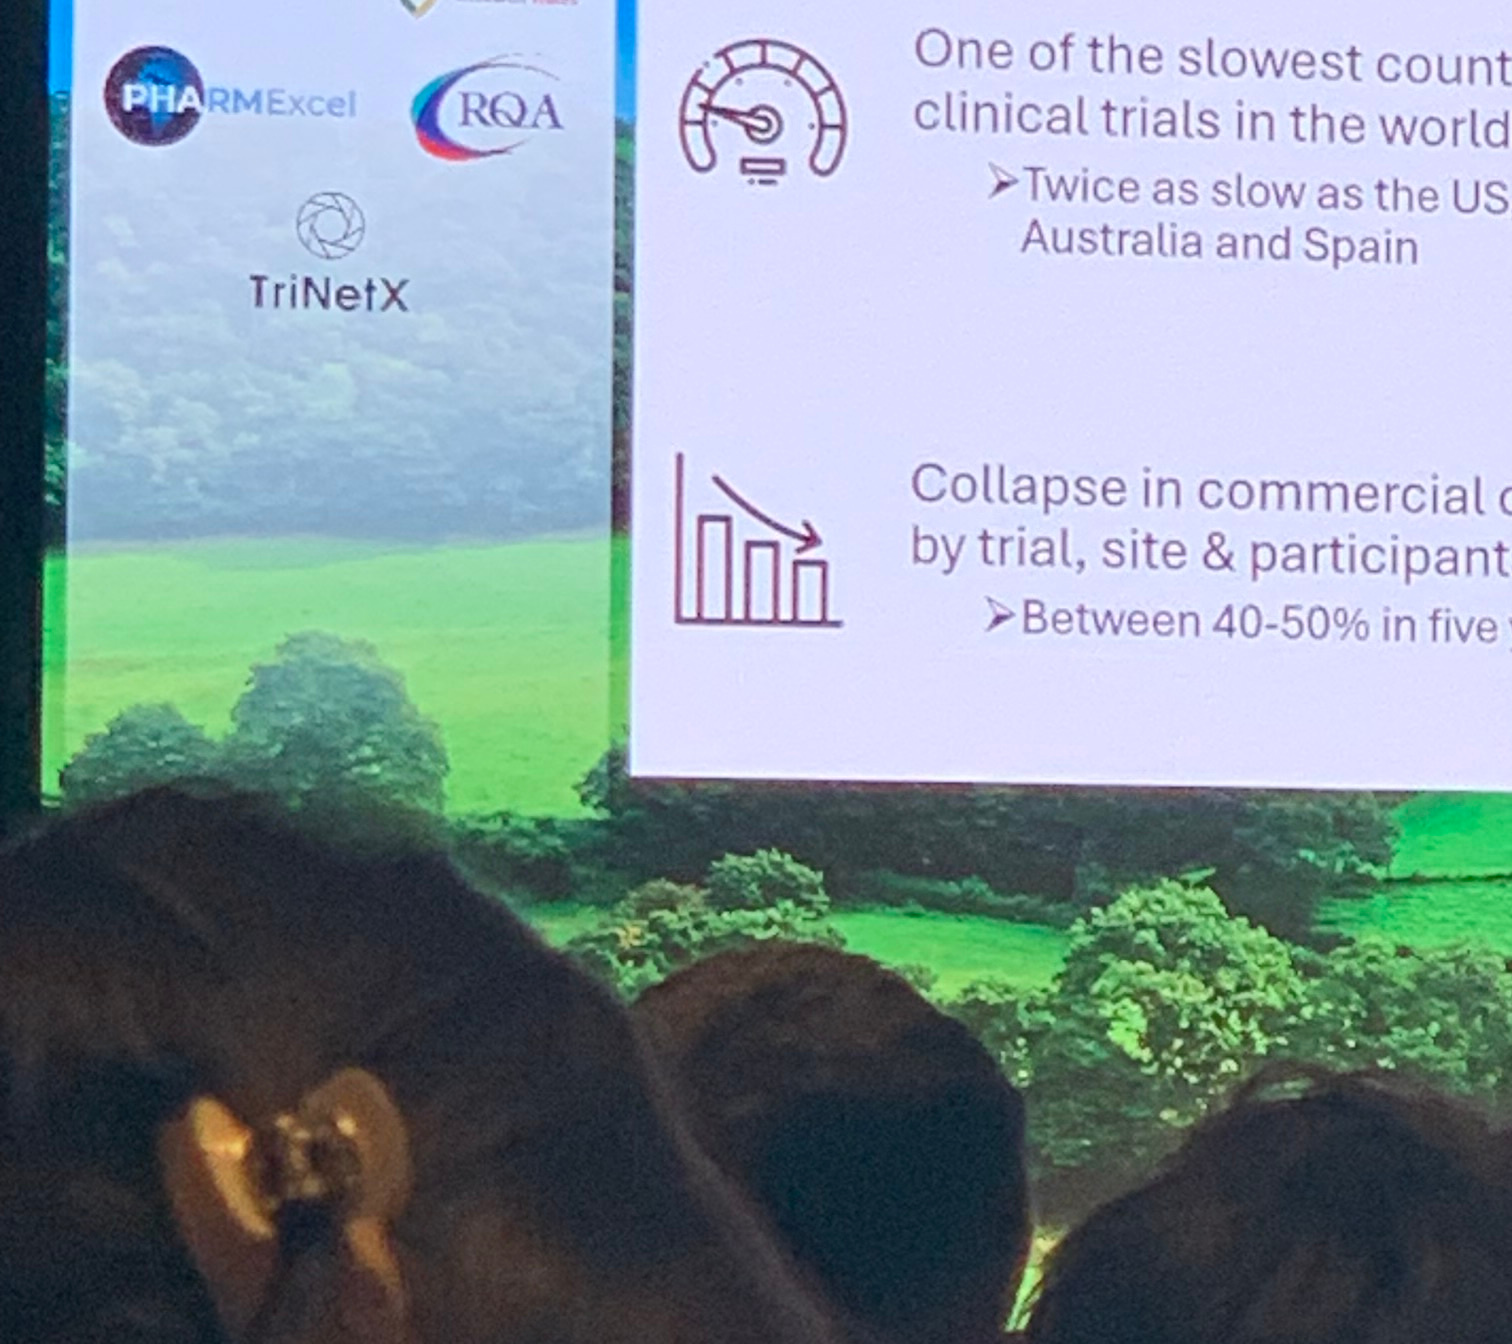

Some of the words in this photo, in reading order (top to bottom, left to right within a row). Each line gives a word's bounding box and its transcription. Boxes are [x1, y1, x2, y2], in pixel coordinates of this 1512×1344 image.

[916, 28, 1012, 69] One
[1030, 33, 1074, 71] of
[1087, 35, 1162, 74] the
[1180, 38, 1362, 81] slowest
[122, 84, 356, 118] PHARMExcel
[461, 92, 563, 129] RQA
[915, 91, 1088, 135] clinical
[1101, 98, 1220, 138] trials
[1237, 100, 1274, 141] in
[1290, 104, 1364, 143] the
[1380, 109, 1509, 148] world
[1023, 167, 1139, 203] Twice
[1153, 178, 1198, 205] as
[1212, 173, 1306, 208] slow
[1318, 183, 1362, 210] as
[1375, 178, 1438, 212] the
[1021, 219, 1201, 257] Australia
[1217, 226, 1290, 260] and
[1304, 227, 1417, 269] Spain
[250, 274, 409, 312] TriNetX
[912, 463, 1126, 514] Collapse
[1144, 467, 1181, 508] in
[1199, 474, 1485, 515] commercial
[913, 525, 965, 575] by
[978, 526, 1085, 574] trial,
[1103, 528, 1186, 569] site
[1203, 532, 1234, 571] &
[1024, 599, 1200, 637] Between
[1213, 604, 1369, 640] 40-50%
[1384, 607, 1415, 642] in
[1429, 608, 1497, 643] five
